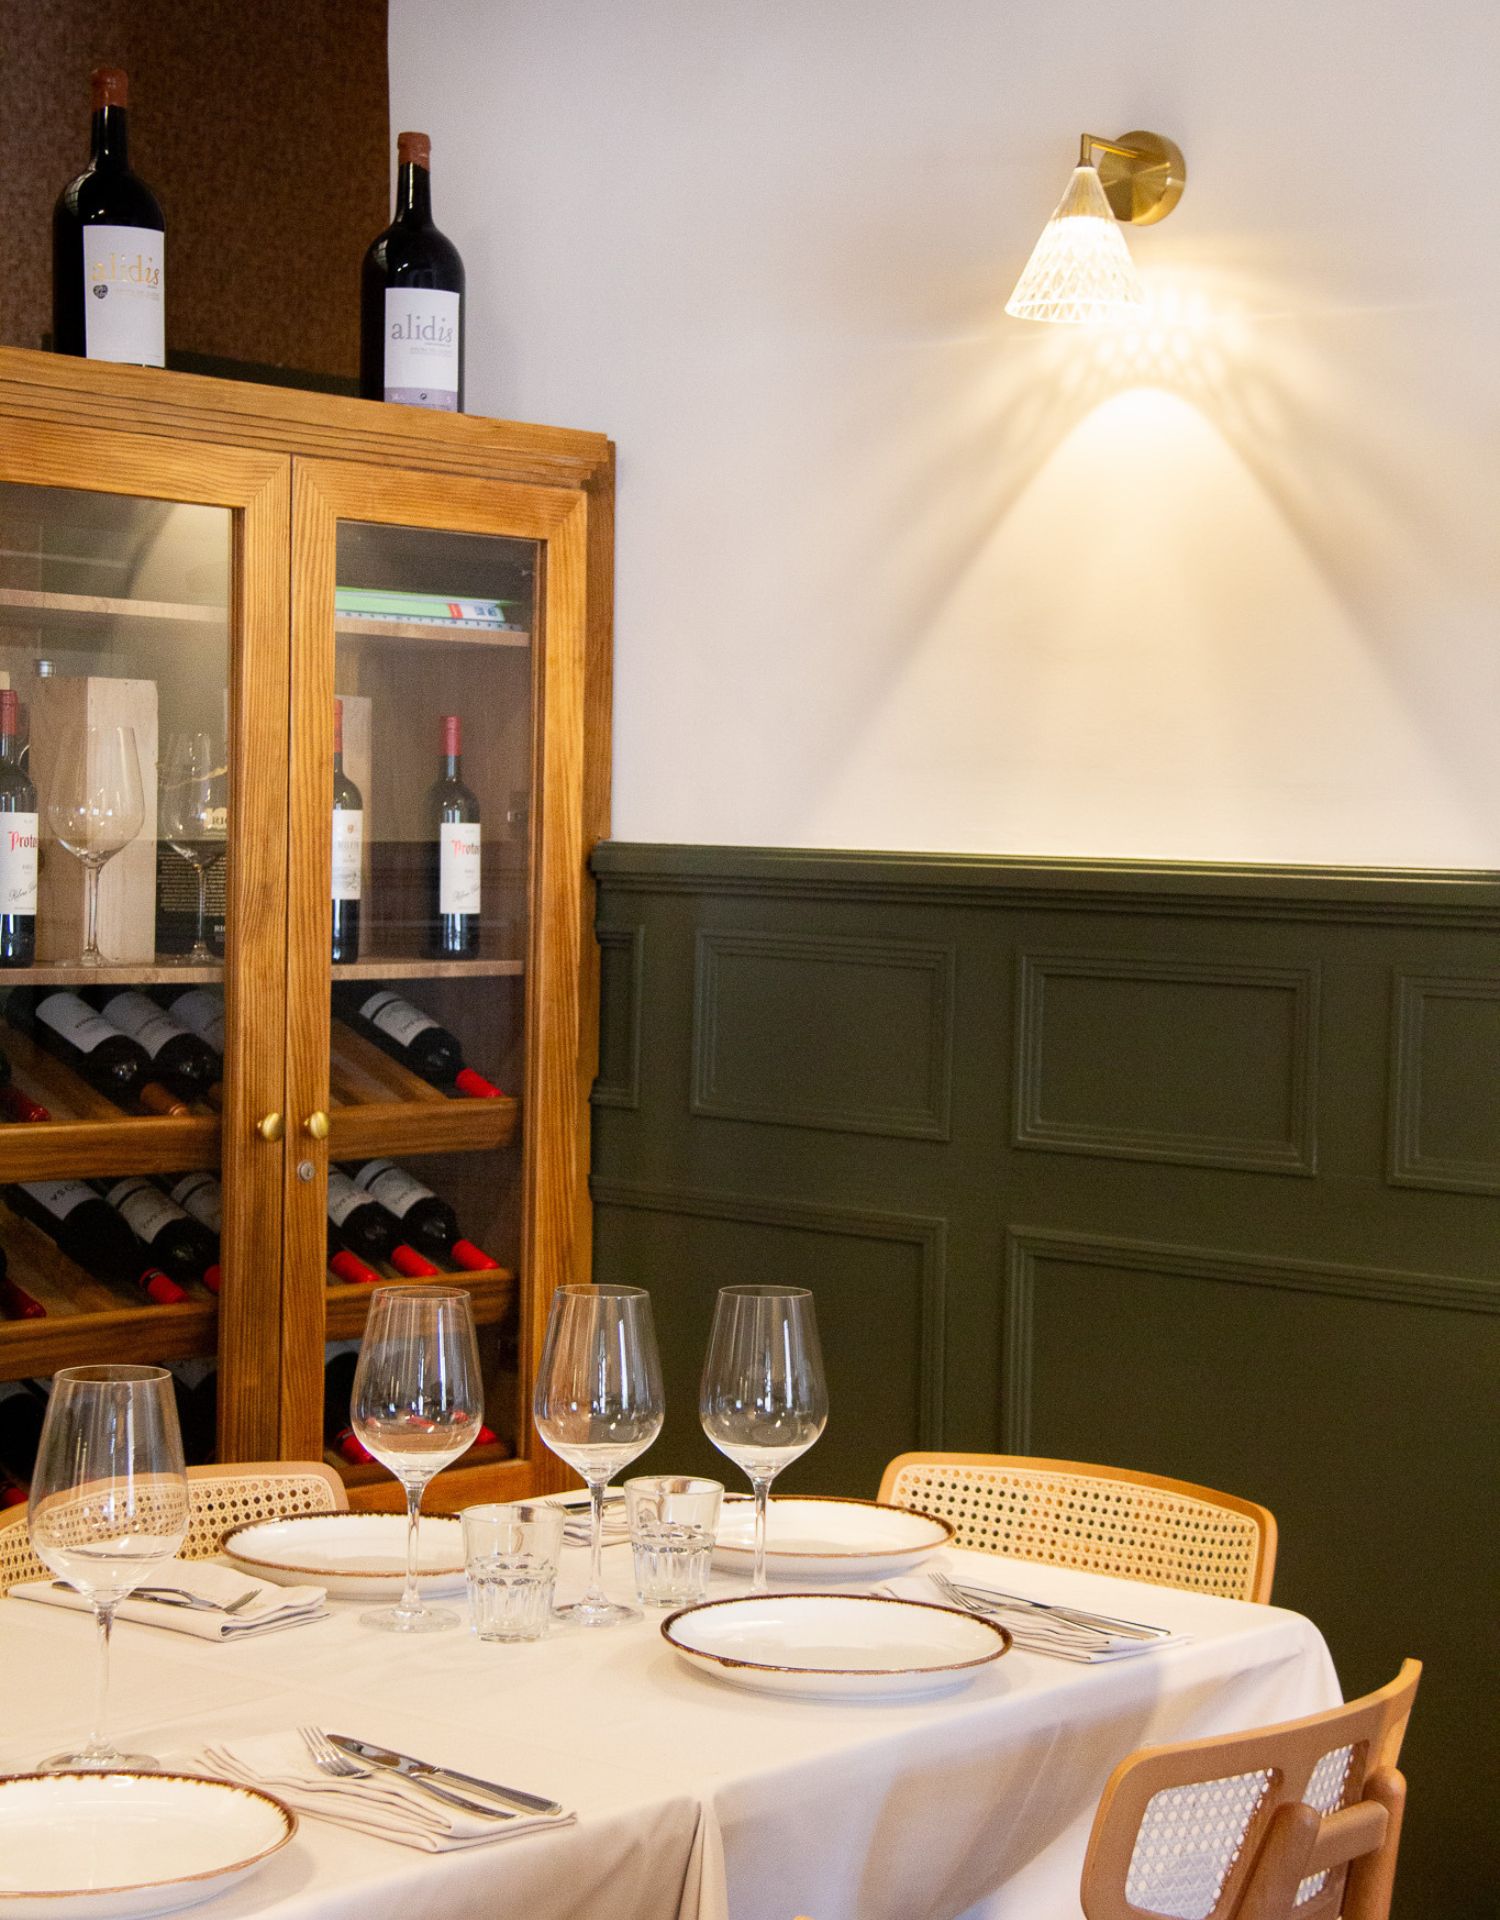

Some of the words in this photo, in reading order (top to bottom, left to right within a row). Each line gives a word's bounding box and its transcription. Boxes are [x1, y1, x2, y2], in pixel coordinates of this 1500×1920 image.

[92, 253, 161, 285] alidis
[391, 314, 454, 343] alidis
[8, 831, 39, 852] Proto
[451, 840, 480, 857] Proto
